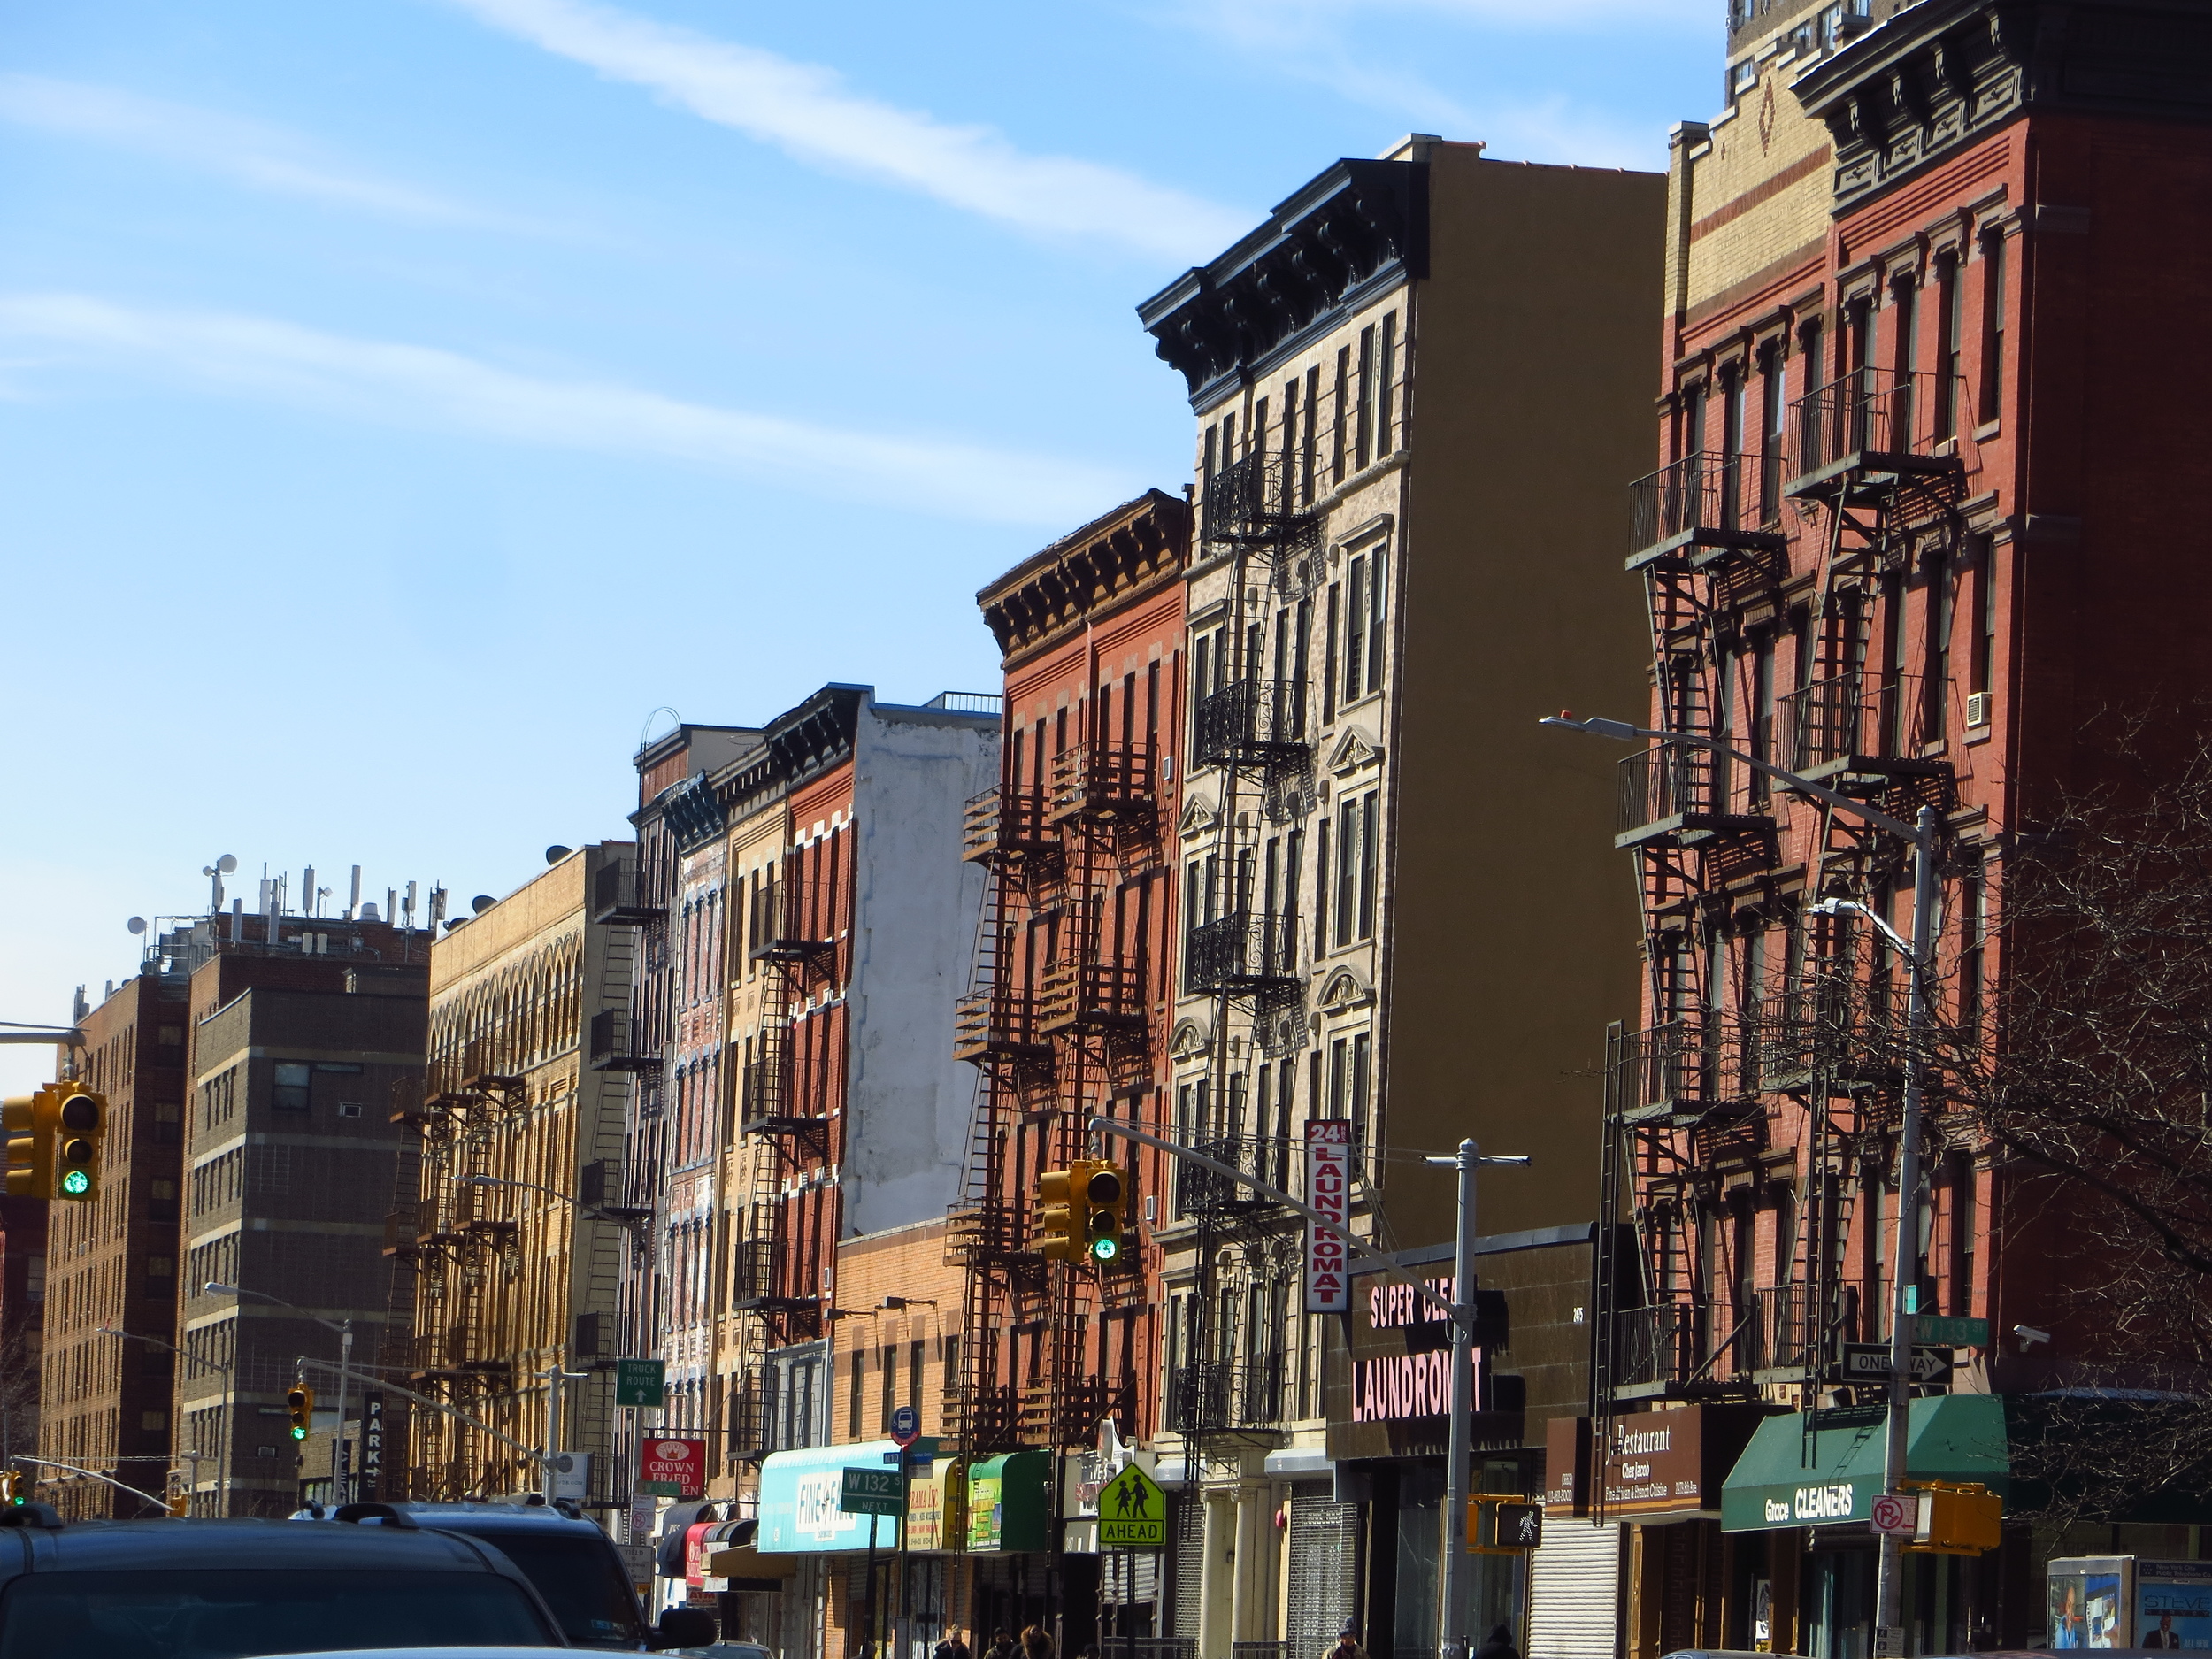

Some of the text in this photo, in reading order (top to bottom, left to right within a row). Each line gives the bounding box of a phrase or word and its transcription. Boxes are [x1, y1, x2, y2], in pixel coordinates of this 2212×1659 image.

[1310, 1125, 1340, 1142] 24
[1313, 1148, 1342, 1303] LAUNDROMAT
[1371, 1284, 1415, 1328] SUPER
[1920, 1319, 1932, 1339] W
[1939, 1321, 1967, 1340] 133
[627, 1363, 656, 1373] TRUCK
[1859, 1355, 1890, 1371] ONE
[626, 1376, 655, 1386] ROUTE
[1353, 1348, 1482, 1422] LAUNDROMT
[367, 1402, 381, 1463] PARK
[1617, 1425, 1671, 1455] Restaurant
[649, 1461, 695, 1472] CROWN
[849, 1473, 861, 1490] W
[864, 1474, 890, 1492] 132
[799, 1482, 821, 1524] FINE
[862, 1502, 888, 1511] NEXT
[1765, 1483, 1853, 1522] Grace CLEANERS
[1106, 1524, 1157, 1539] AHEAD
[2145, 1595, 2210, 1609] STEVE
